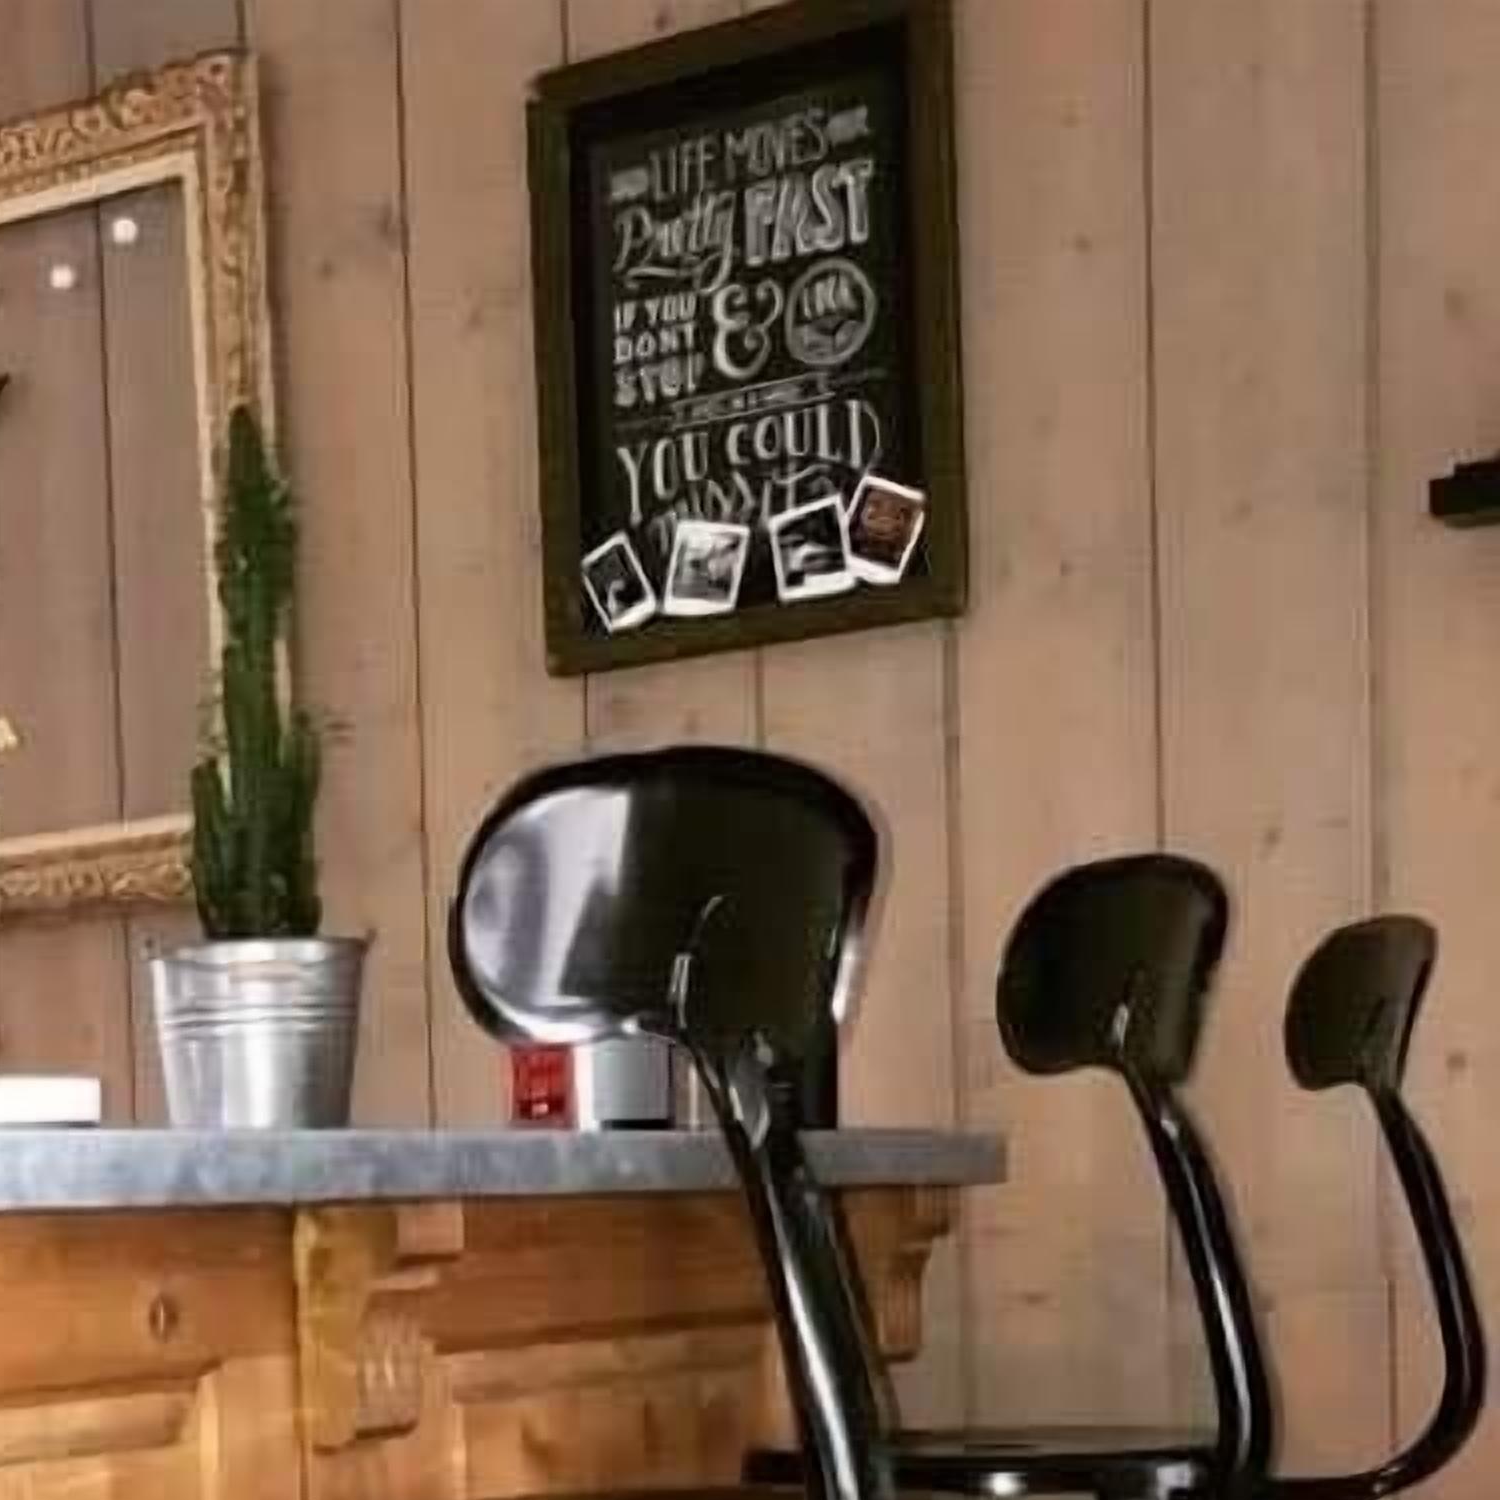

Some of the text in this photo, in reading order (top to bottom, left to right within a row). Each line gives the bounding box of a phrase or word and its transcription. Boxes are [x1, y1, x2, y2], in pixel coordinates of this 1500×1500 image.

[650, 107, 829, 200] LIFE MOVES
[744, 158, 874, 266] FAST
[644, 291, 697, 327] YOU
[616, 432, 709, 526] YOU
[726, 399, 882, 477] COULD
